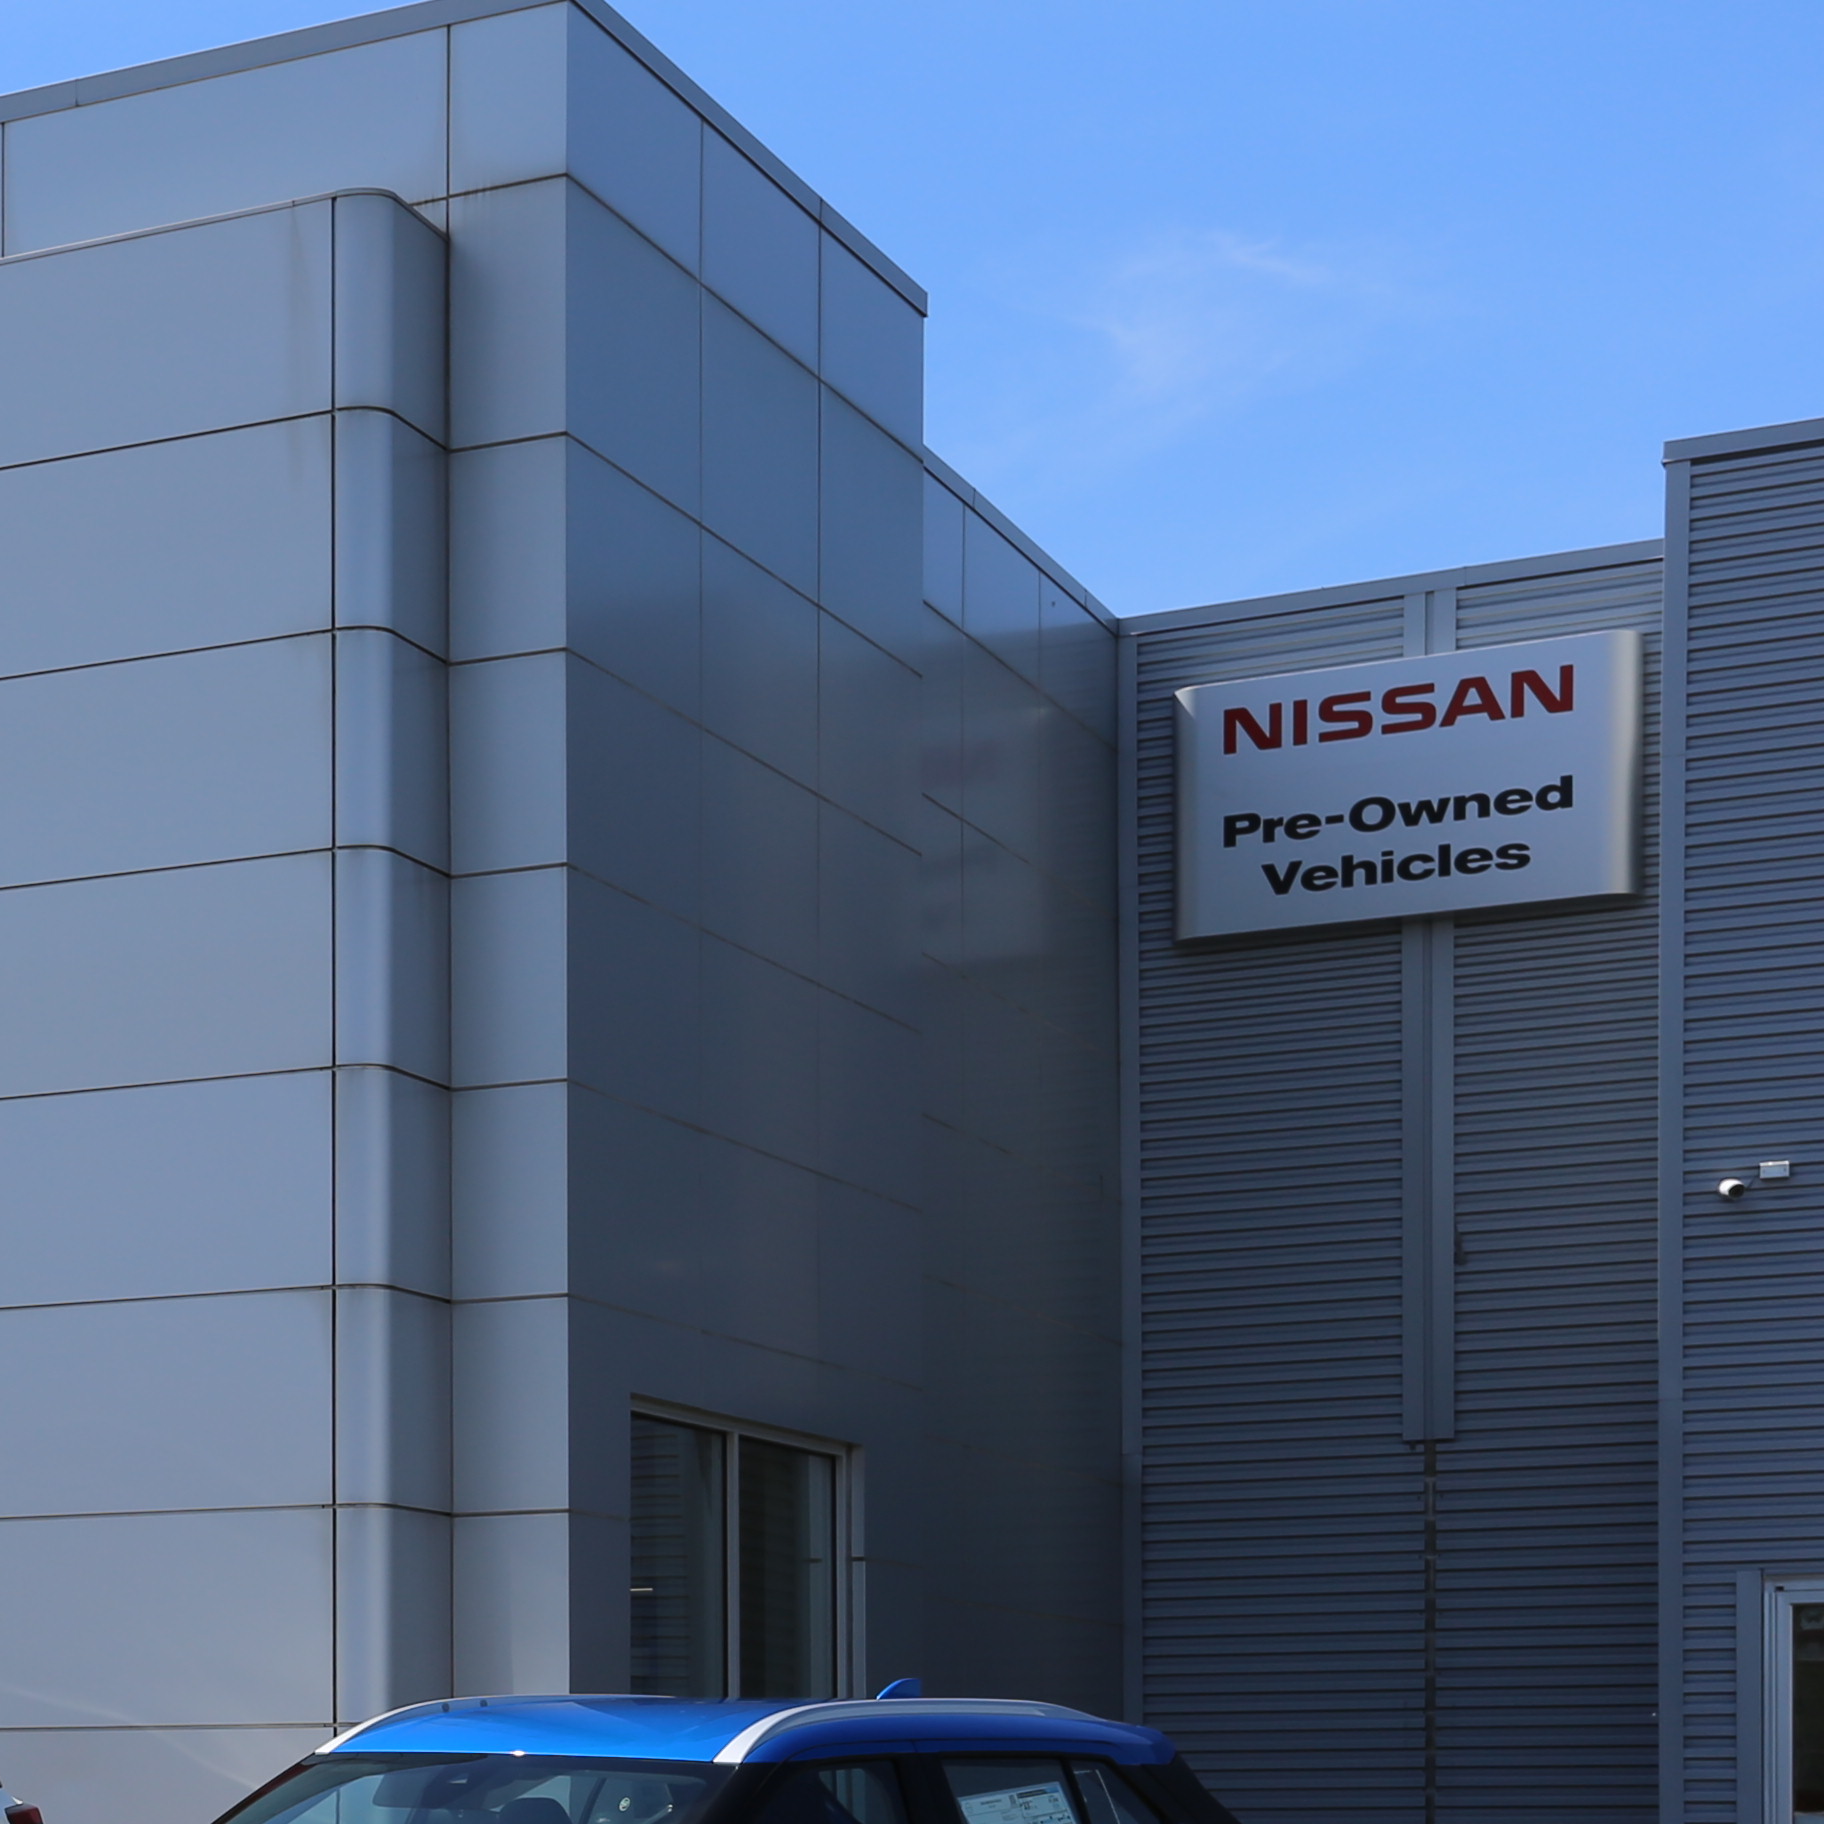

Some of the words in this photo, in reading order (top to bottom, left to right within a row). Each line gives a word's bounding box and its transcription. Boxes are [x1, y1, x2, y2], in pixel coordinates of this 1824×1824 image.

[1223, 664, 1574, 755] NISSAN
[1223, 775, 1573, 848] Pre-Owned
[1260, 842, 1531, 896] Vehicles
